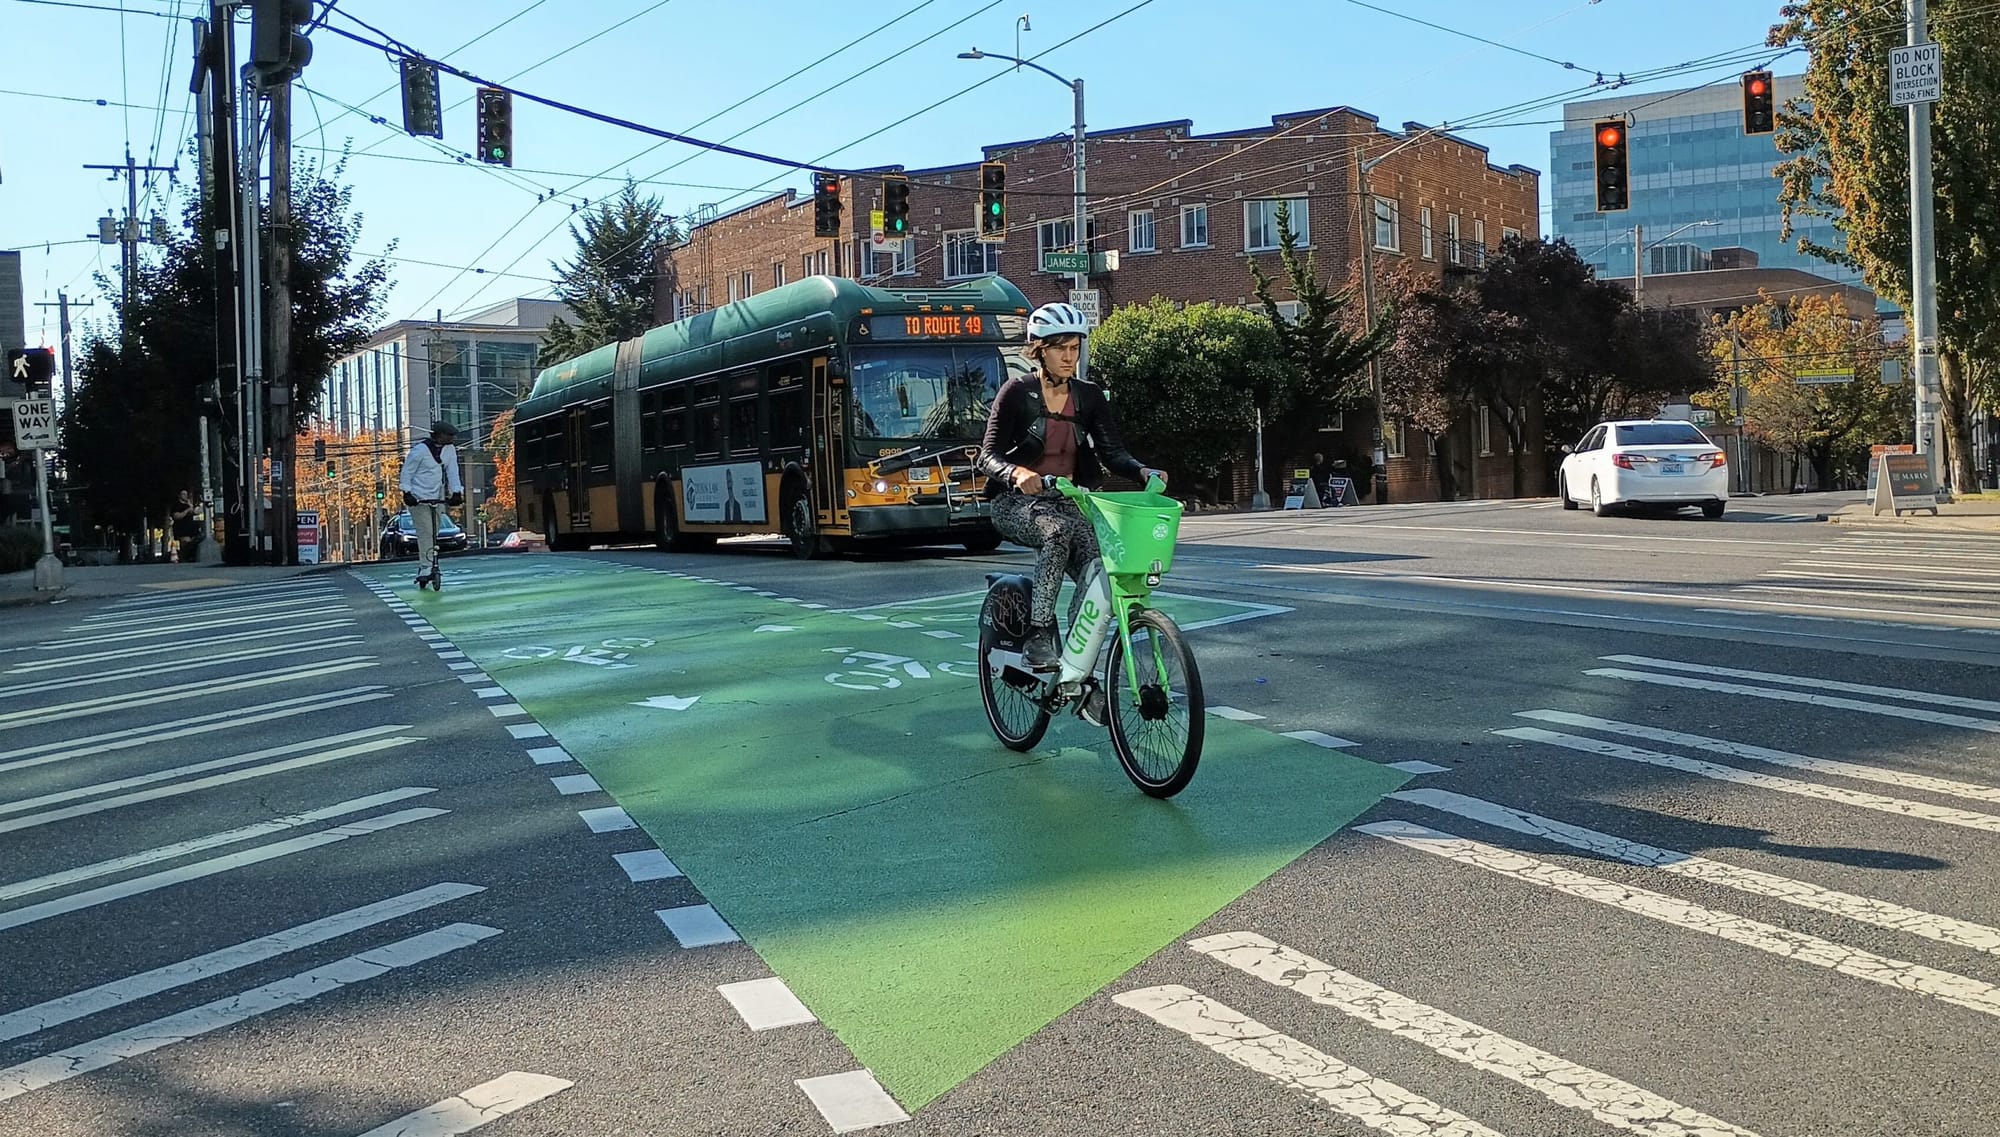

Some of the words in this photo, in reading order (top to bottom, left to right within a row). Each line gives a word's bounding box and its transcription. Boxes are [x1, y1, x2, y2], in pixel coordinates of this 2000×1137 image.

[1894, 52, 1909, 65] DO
[1914, 48, 1937, 61] NOT
[1896, 63, 1935, 79] BLOCK
[1893, 77, 1938, 90] INTERSECTION
[1917, 88, 1936, 97] FINE
[1047, 258, 1077, 268] JAMES
[1080, 260, 1088, 268] ST
[1072, 293, 1081, 301] DO
[1084, 293, 1097, 301] NOT
[1074, 302, 1096, 311] BLOCK
[905, 316, 920, 334] TO
[924, 316, 961, 334] ROUTE
[965, 316, 982, 334] 49
[18, 403, 49, 415] ONE
[19, 416, 51, 429] WAY
[296, 516, 315, 524] PEN
